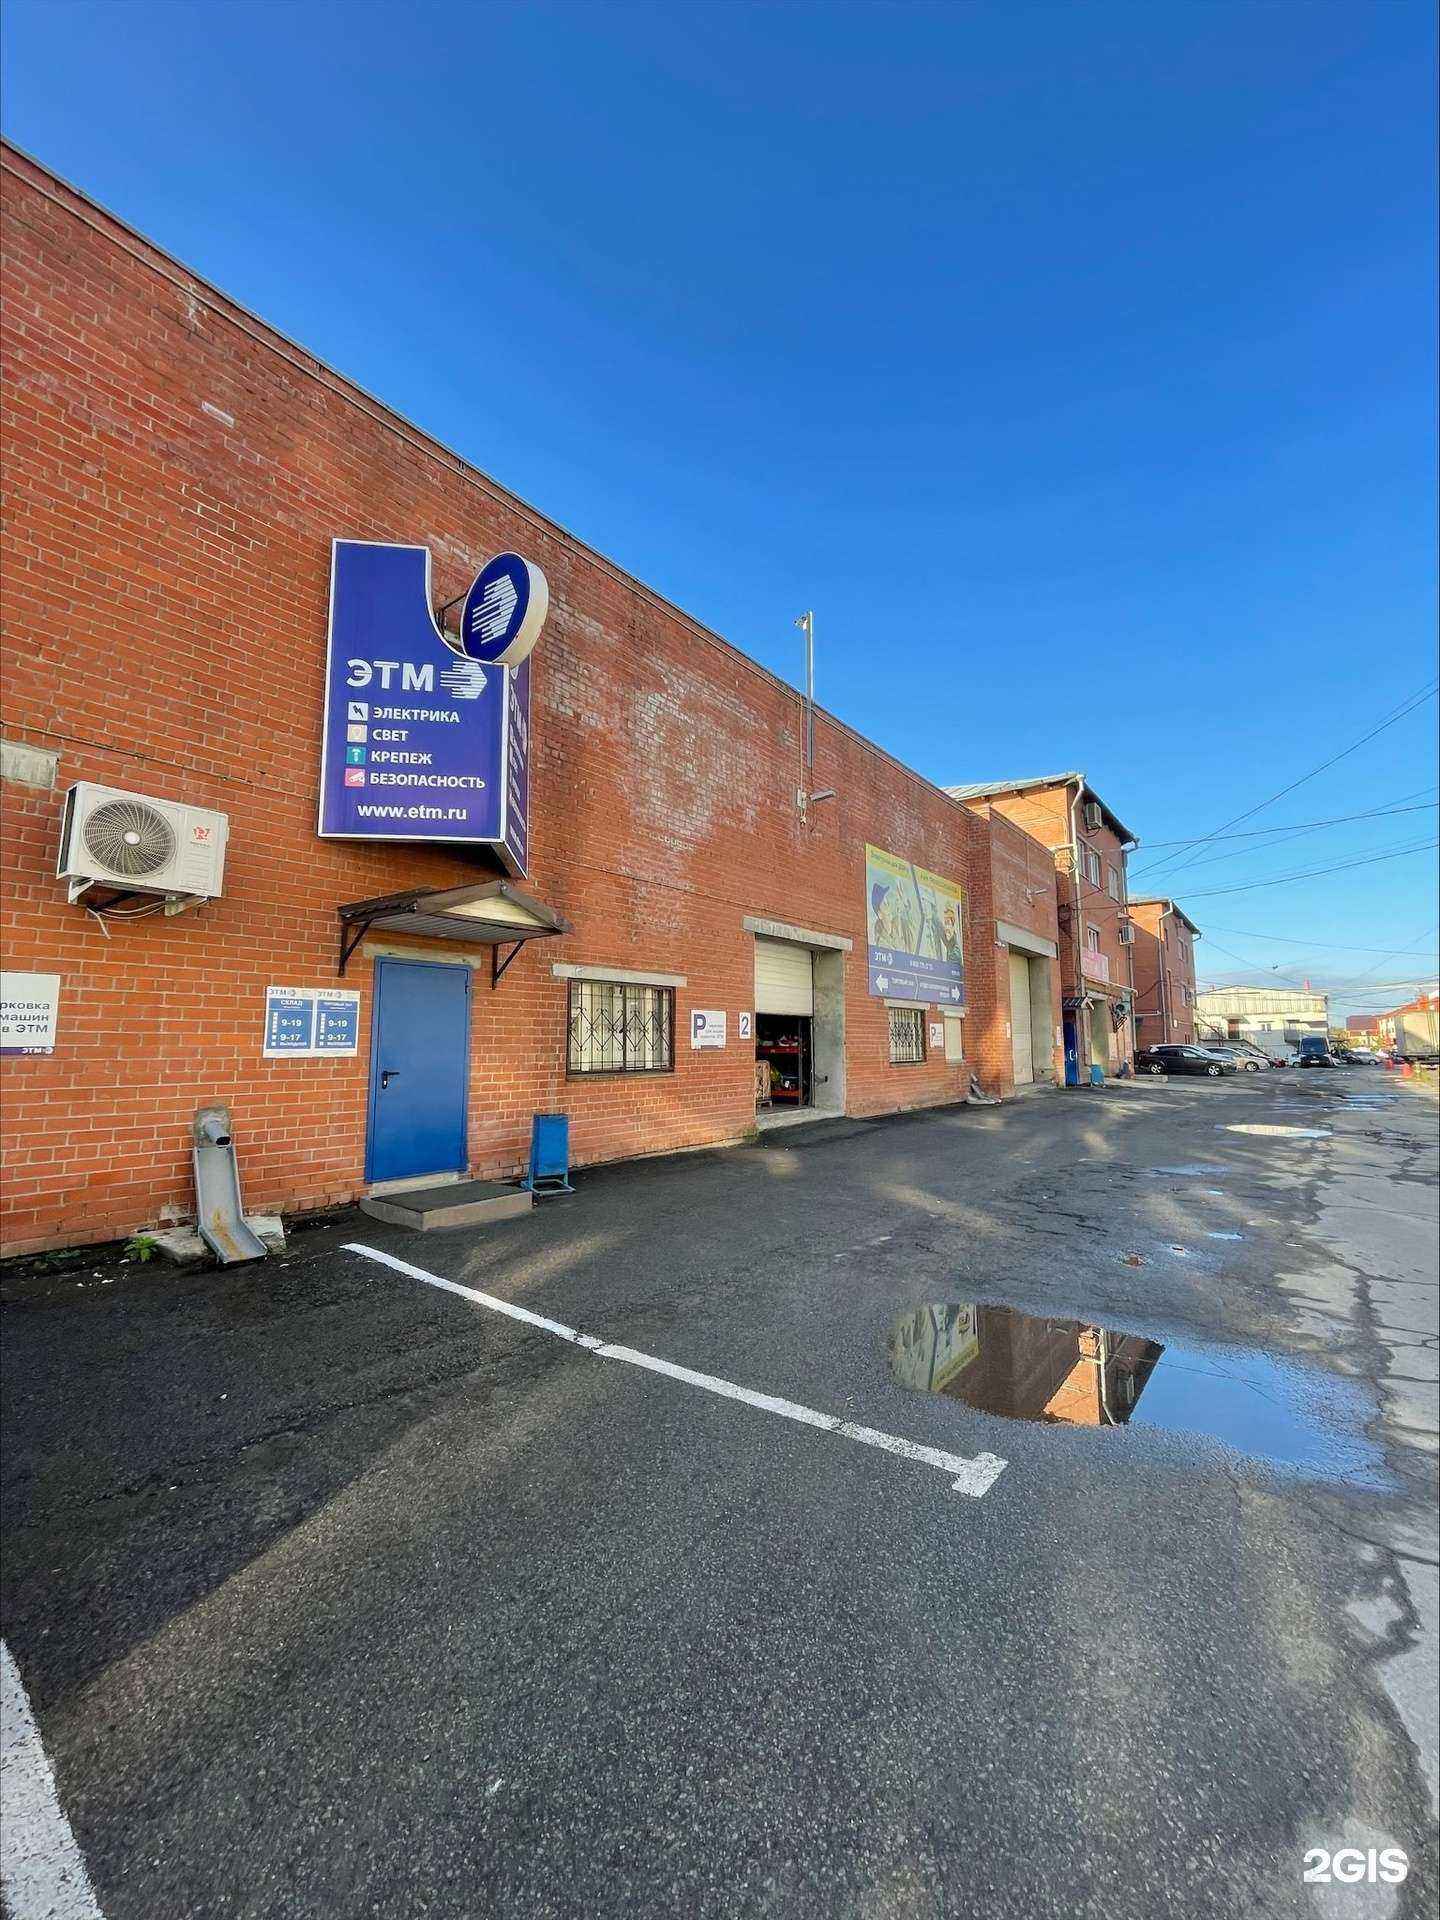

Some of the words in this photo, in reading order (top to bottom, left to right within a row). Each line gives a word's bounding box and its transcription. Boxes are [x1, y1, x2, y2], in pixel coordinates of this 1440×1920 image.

[346, 658, 434, 692] ЭТМ
[373, 706, 460, 723] ЭЛЕКТРИКА
[372, 729, 408, 742] СВЕТ
[371, 750, 432, 765] КРЕПЕЖ
[369, 772, 486, 789] БЕЗОПАСНОСТЬ
[357, 804, 467, 820] www.etm.ru
[280, 999, 303, 1008] СКЛАД
[16, 1024, 48, 1033] ЭТМ
[281, 1018, 302, 1027] 9-19
[741, 1016, 749, 1035] 2
[279, 1033, 301, 1041] 9-17
[327, 1033, 347, 1041] 9-17
